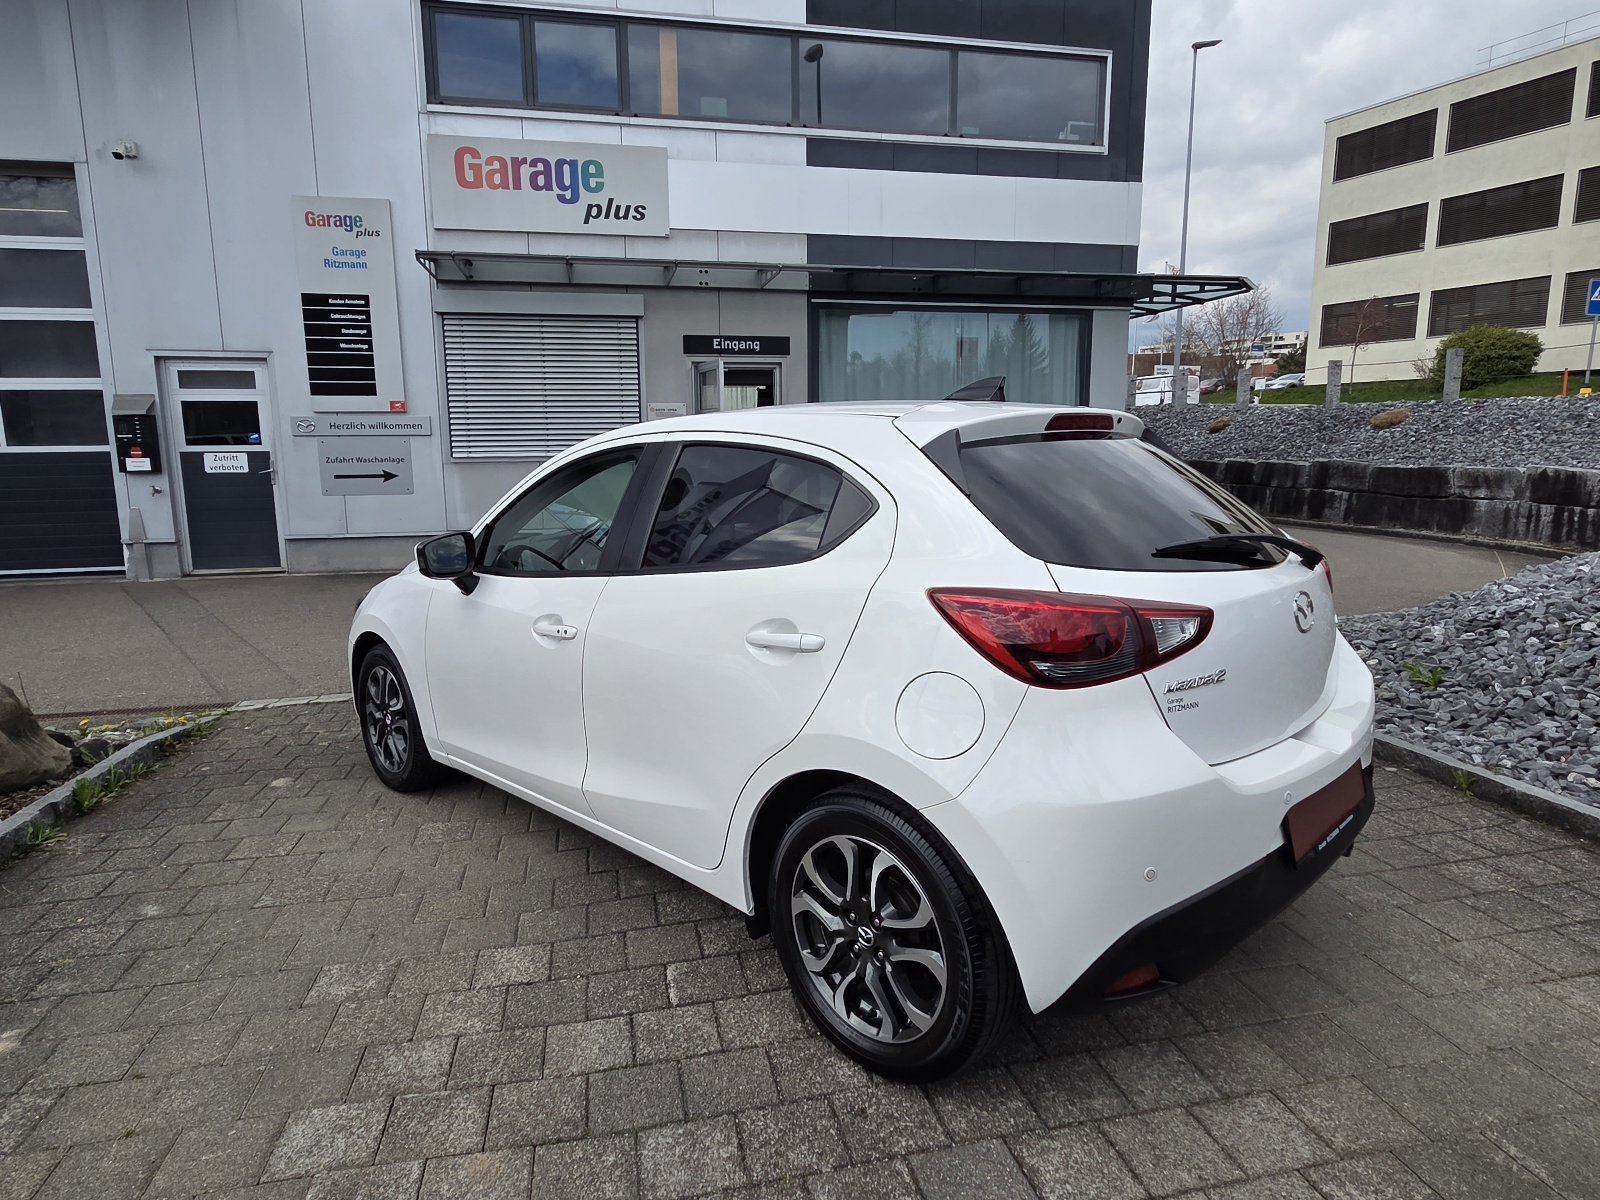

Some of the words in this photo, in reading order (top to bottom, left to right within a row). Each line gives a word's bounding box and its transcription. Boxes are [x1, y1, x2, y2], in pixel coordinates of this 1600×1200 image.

[453, 145, 605, 205] Garage
[583, 197, 647, 225] plus
[304, 211, 363, 232] Garage
[355, 228, 380, 238] plus
[332, 246, 366, 258] Garage
[324, 259, 367, 269] Ritzmann
[713, 338, 760, 351] Eingang
[329, 421, 366, 430] Herzlich
[368, 421, 423, 431] willkommen
[213, 454, 239, 462] Zutritt
[325, 456, 354, 464] Zufahrt
[355, 456, 405, 465] Waschanlage
[209, 463, 245, 472] verboten
[1166, 697, 1184, 705] Garage
[1167, 701, 1199, 714] RITZMANN
